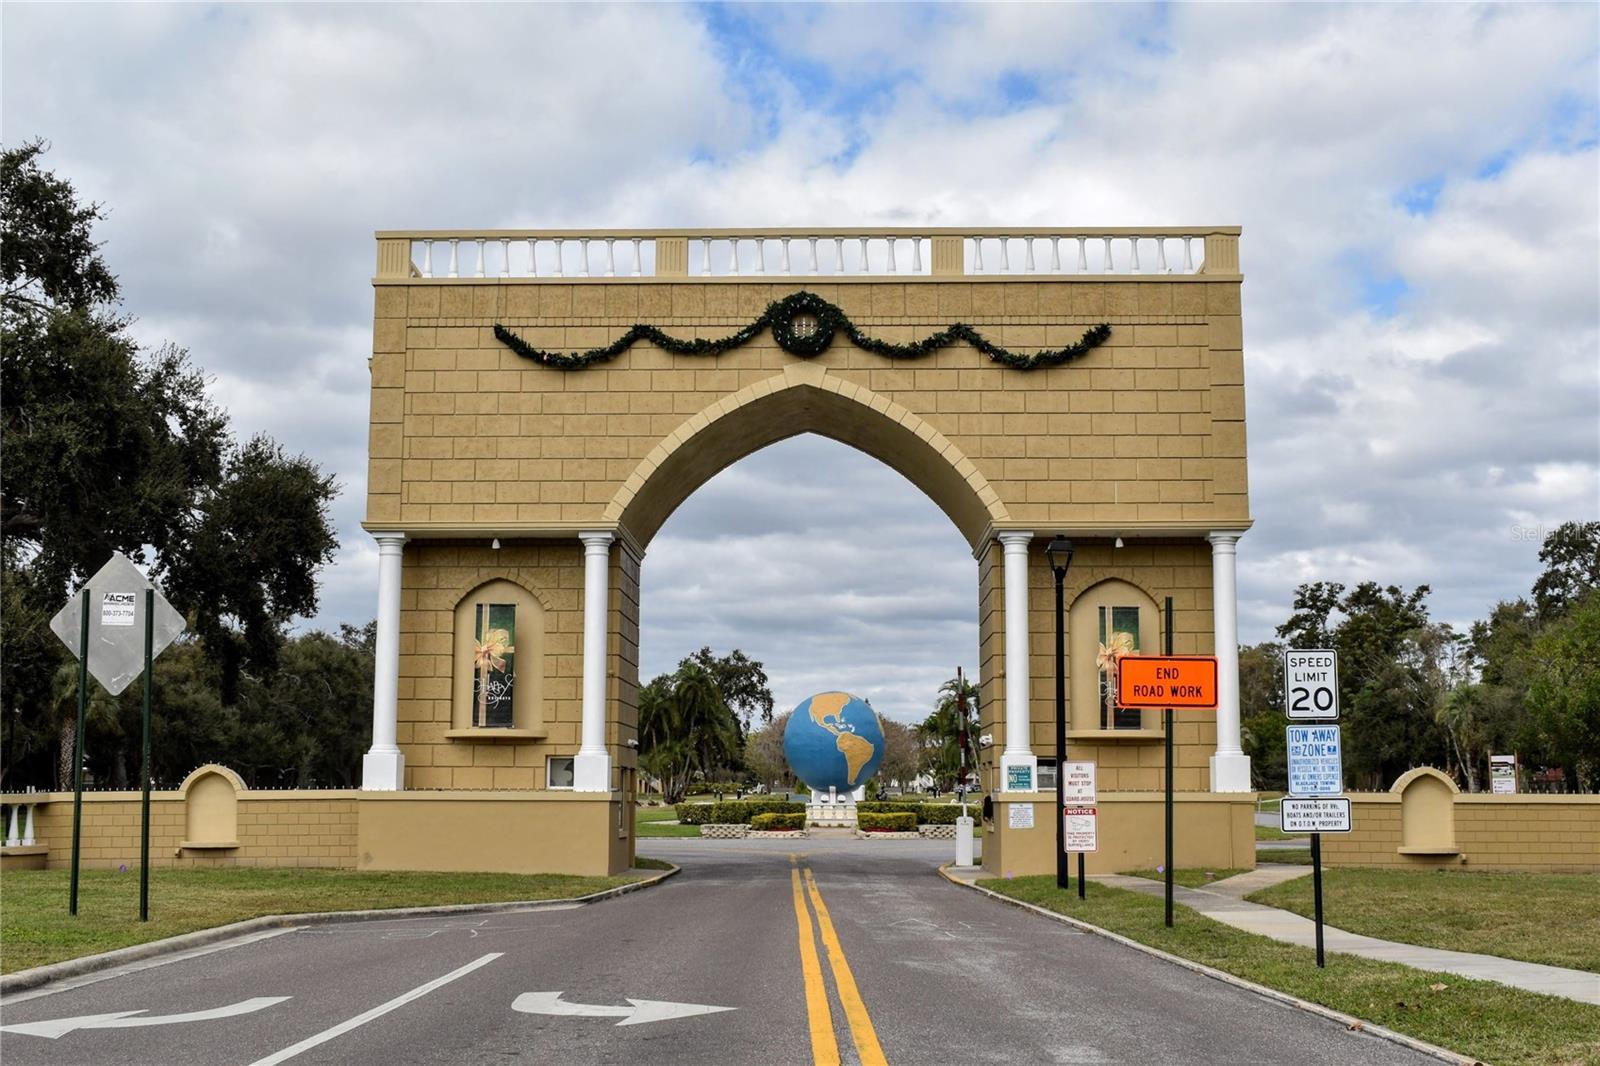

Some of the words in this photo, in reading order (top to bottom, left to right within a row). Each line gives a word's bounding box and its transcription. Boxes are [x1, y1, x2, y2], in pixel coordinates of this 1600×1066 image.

[109, 594, 135, 602] ACME
[1290, 657, 1332, 668] SPEED
[1156, 667, 1180, 680] END
[1294, 672, 1328, 682] LIMIT
[1133, 685, 1165, 697] ROAD
[1170, 686, 1203, 698] WORK
[1291, 686, 1334, 711] 20
[1290, 730, 1309, 742] TOW
[1313, 729, 1337, 742] AWAY
[1302, 743, 1327, 757] ZONE
